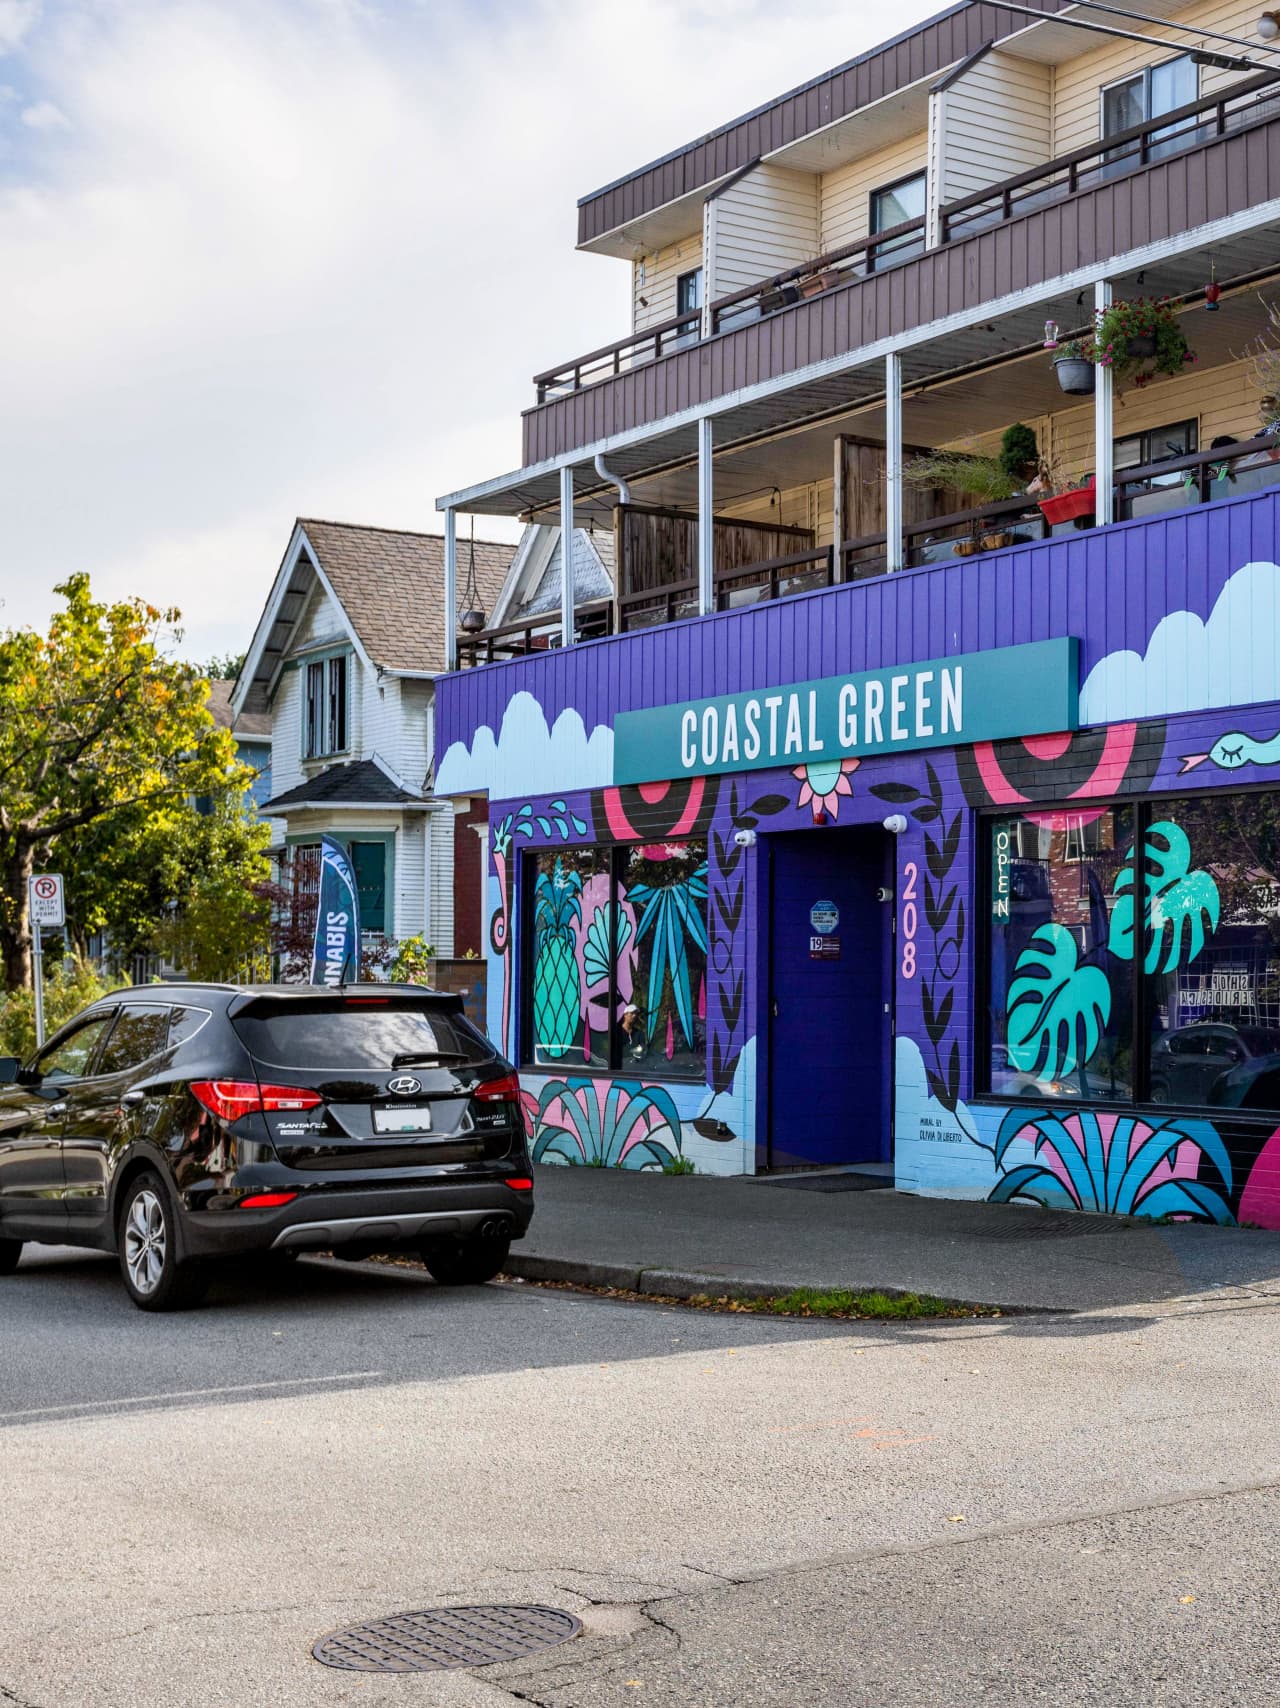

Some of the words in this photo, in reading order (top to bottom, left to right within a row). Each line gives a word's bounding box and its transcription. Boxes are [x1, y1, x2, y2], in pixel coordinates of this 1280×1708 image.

[681, 690, 824, 768] COASTAL
[838, 666, 963, 748] GREEN
[902, 862, 918, 979] 208
[996, 832, 1009, 917] OPEN
[811, 938, 822, 950] 19
